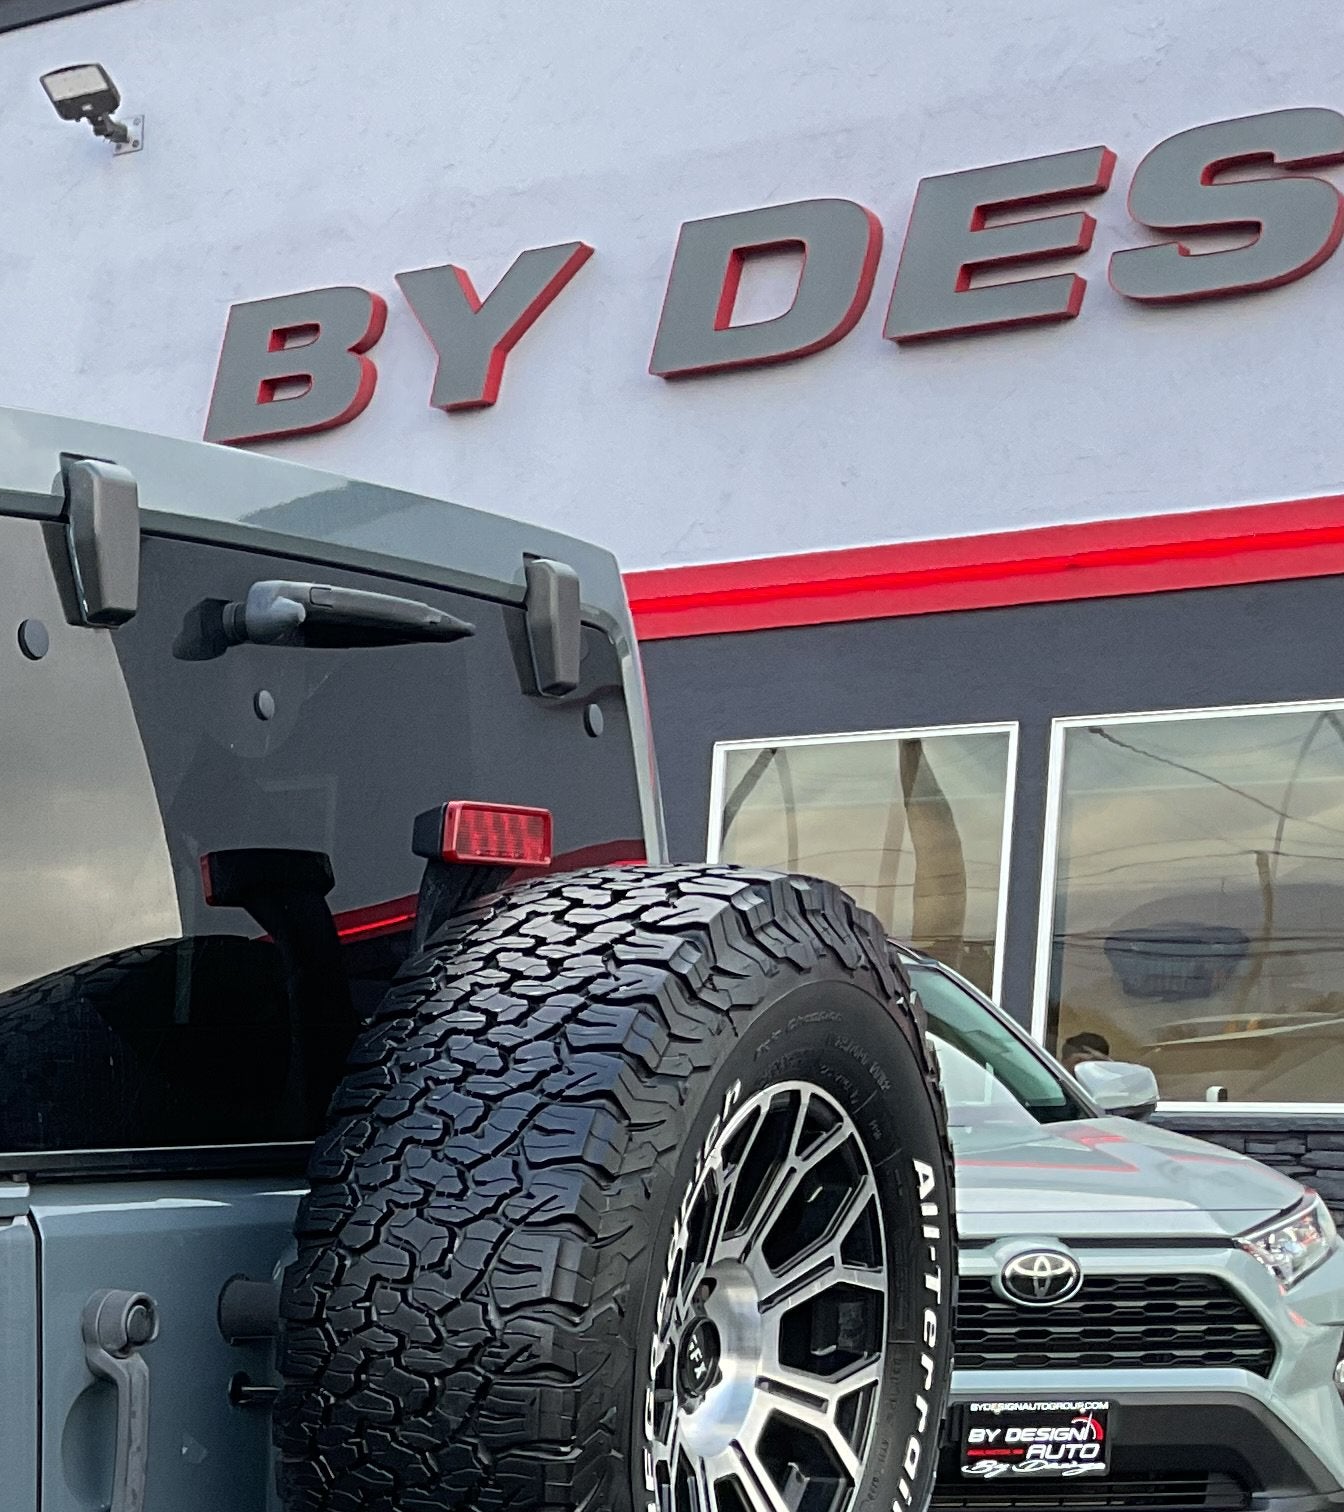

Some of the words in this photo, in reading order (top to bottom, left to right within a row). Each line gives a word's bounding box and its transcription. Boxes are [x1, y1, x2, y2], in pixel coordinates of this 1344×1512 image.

[203, 240, 594, 446] BY
[648, 105, 1344, 381] DES
[968, 1428, 1002, 1443] BY
[1005, 1427, 1088, 1442] DESIGN
[1026, 1443, 1101, 1460] AUTO
